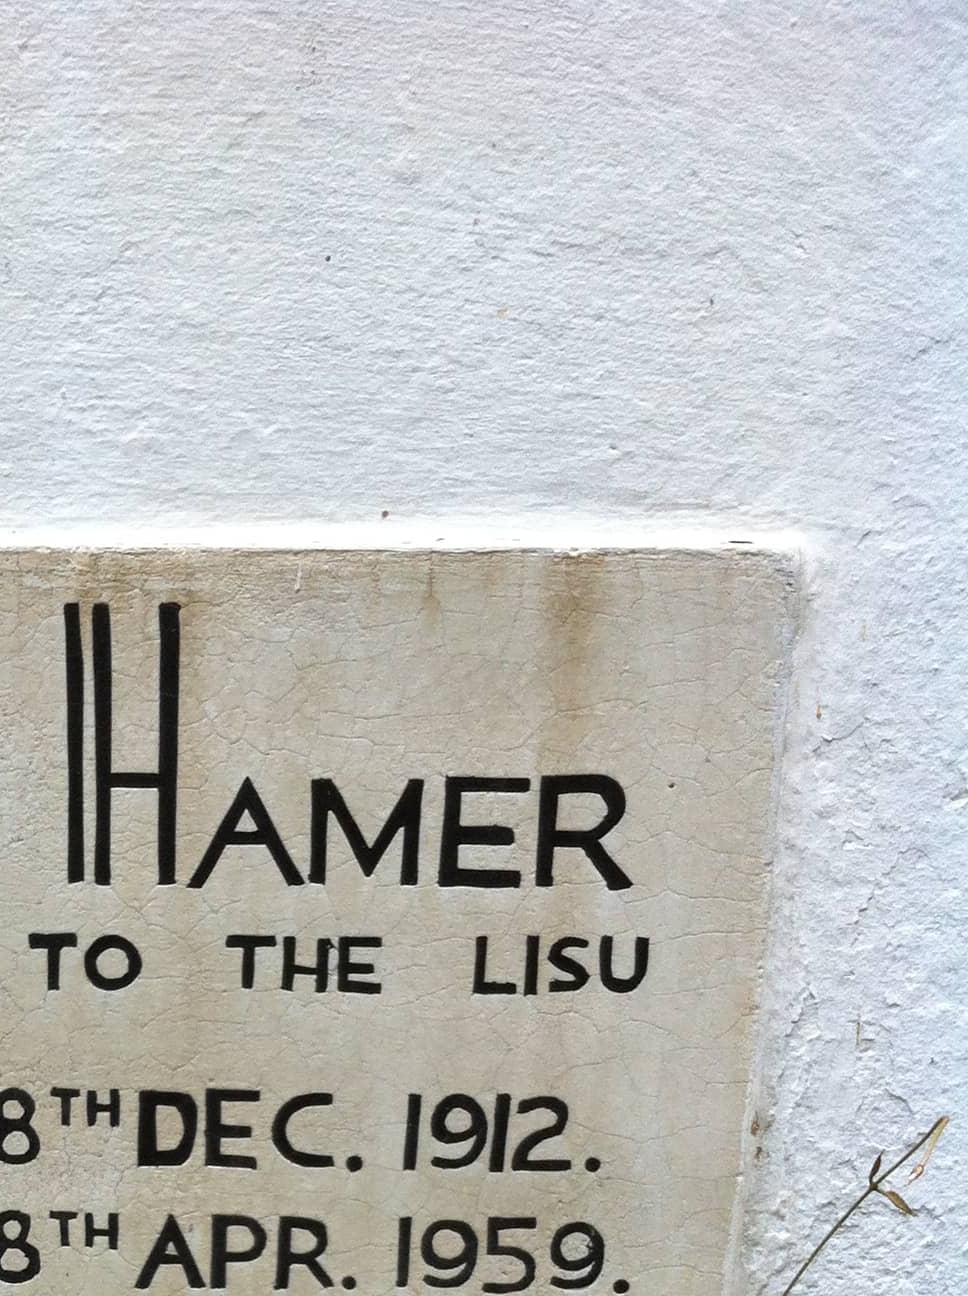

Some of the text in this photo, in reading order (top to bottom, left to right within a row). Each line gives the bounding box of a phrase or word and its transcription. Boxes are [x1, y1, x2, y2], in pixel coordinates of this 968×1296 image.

[64, 601, 634, 891] HAMER
[28, 932, 143, 992] TO
[225, 934, 383, 996] THE
[472, 934, 650, 997] LISU
[137, 1089, 363, 1173] DEC.
[403, 1093, 602, 1174] 1912.
[134, 1213, 357, 1290] APR.
[395, 1216, 630, 1295] 1959.
